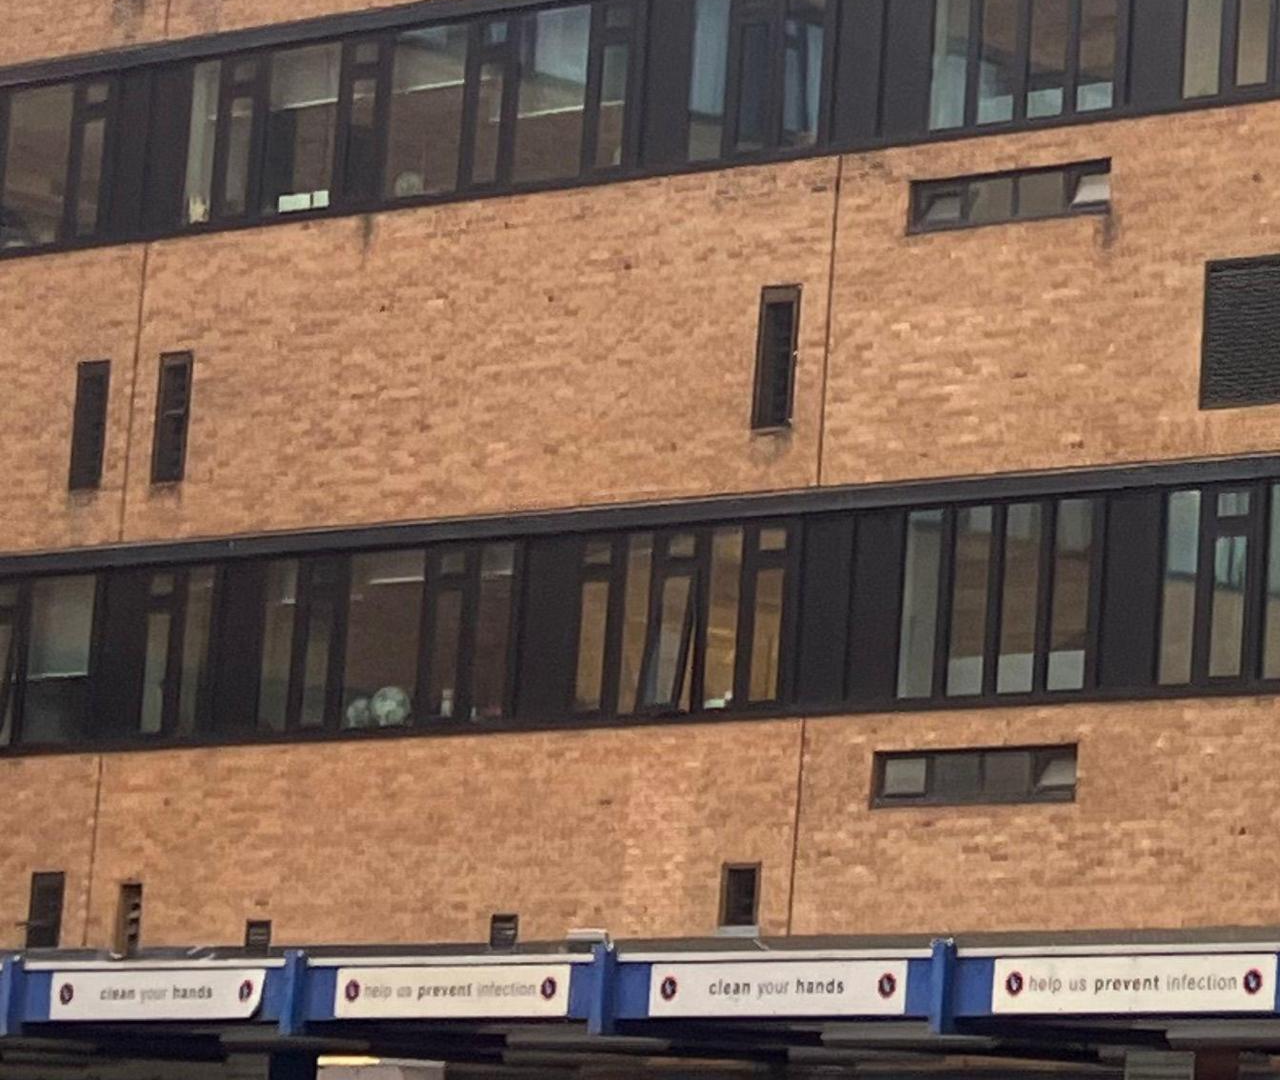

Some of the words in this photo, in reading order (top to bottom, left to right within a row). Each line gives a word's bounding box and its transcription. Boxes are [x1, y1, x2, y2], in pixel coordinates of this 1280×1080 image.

[100, 987, 135, 1000] clean
[172, 985, 213, 1000] hands
[416, 983, 472, 1001] prevent
[477, 981, 536, 997] infection
[709, 979, 751, 996] clean
[757, 981, 790, 999] your
[795, 978, 845, 995] hands
[1028, 975, 1062, 995] help
[1068, 980, 1087, 992] us
[1093, 975, 1160, 995] prevent
[1166, 974, 1237, 991] infection
